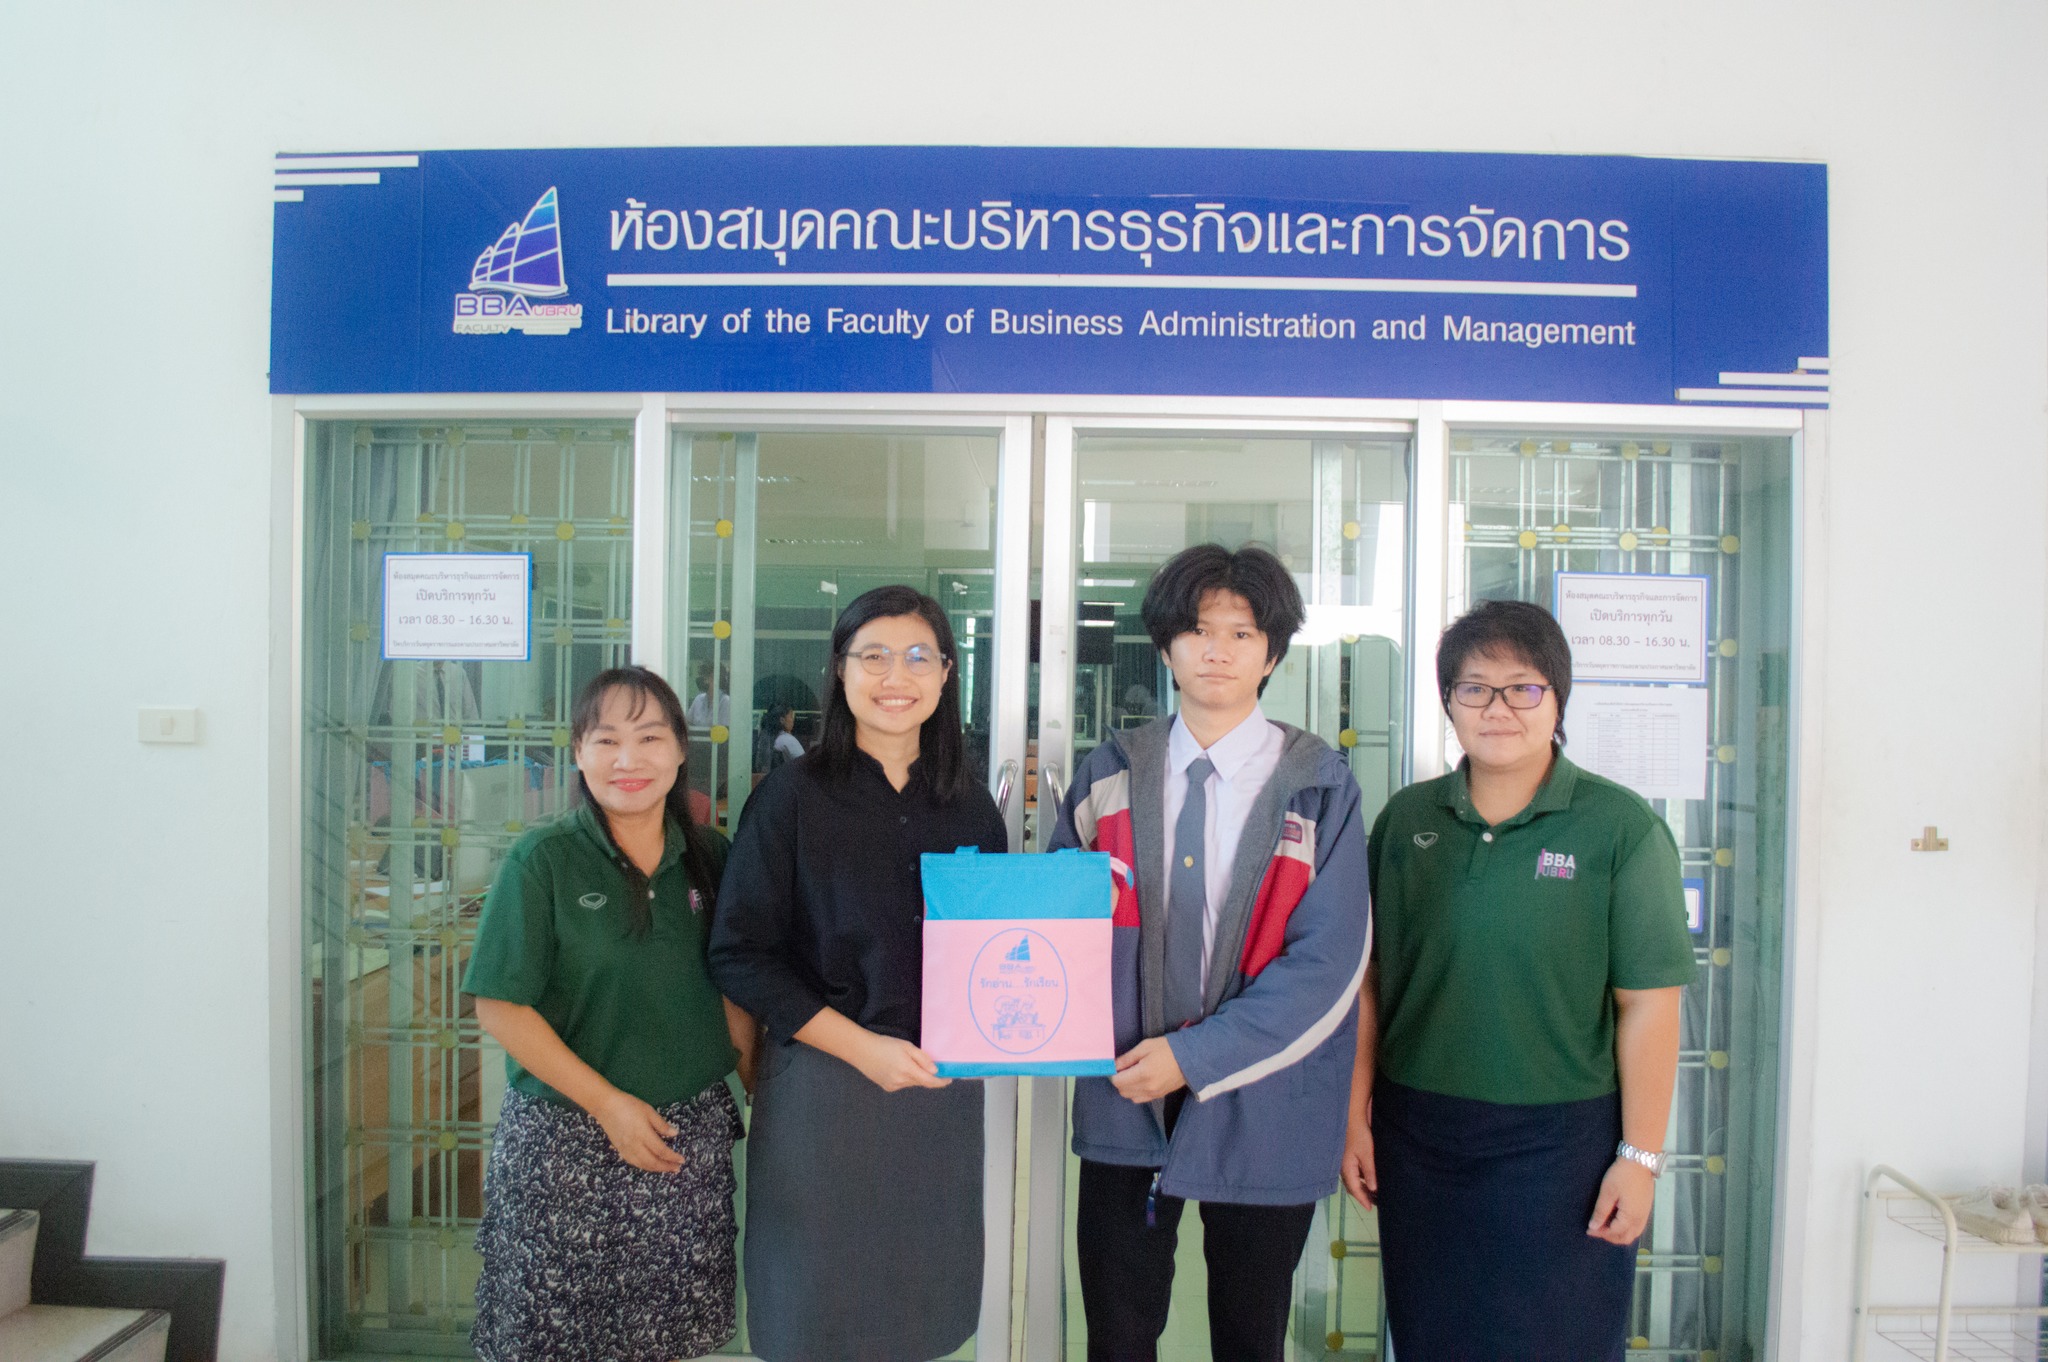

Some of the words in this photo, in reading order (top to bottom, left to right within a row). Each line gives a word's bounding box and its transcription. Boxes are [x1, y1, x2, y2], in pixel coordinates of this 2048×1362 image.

[610, 198, 1630, 267] ห้องสมุดคณะบริหารธุรกิจและการจัดการ
[456, 295, 531, 317] BBA
[533, 304, 581, 317] UBRU
[456, 323, 509, 332] FACULTY
[606, 308, 708, 339] Library
[722, 307, 751, 333] of
[765, 307, 811, 333] the
[827, 307, 930, 339] Faculty
[945, 308, 975, 334] of
[990, 308, 1123, 335] Business
[1138, 309, 1356, 339] Administration
[1371, 314, 1426, 341] and
[1443, 315, 1636, 349] Management
[416, 588, 496, 604] เปิดบริการทุกวัน
[399, 615, 422, 625] เวลา
[425, 615, 455, 625] 08.30
[470, 615, 499, 625] 16.30
[502, 616, 514, 625] น.
[1590, 608, 1673, 626] เปิดบริการทุกวัน
[1571, 636, 1595, 646] เวลา
[1599, 635, 1630, 646] 08.30
[1645, 636, 1675, 647] 16.30
[1679, 638, 1690, 648] น.
[1543, 852, 1576, 869] BBA
[1541, 866, 1575, 879] UBRU
